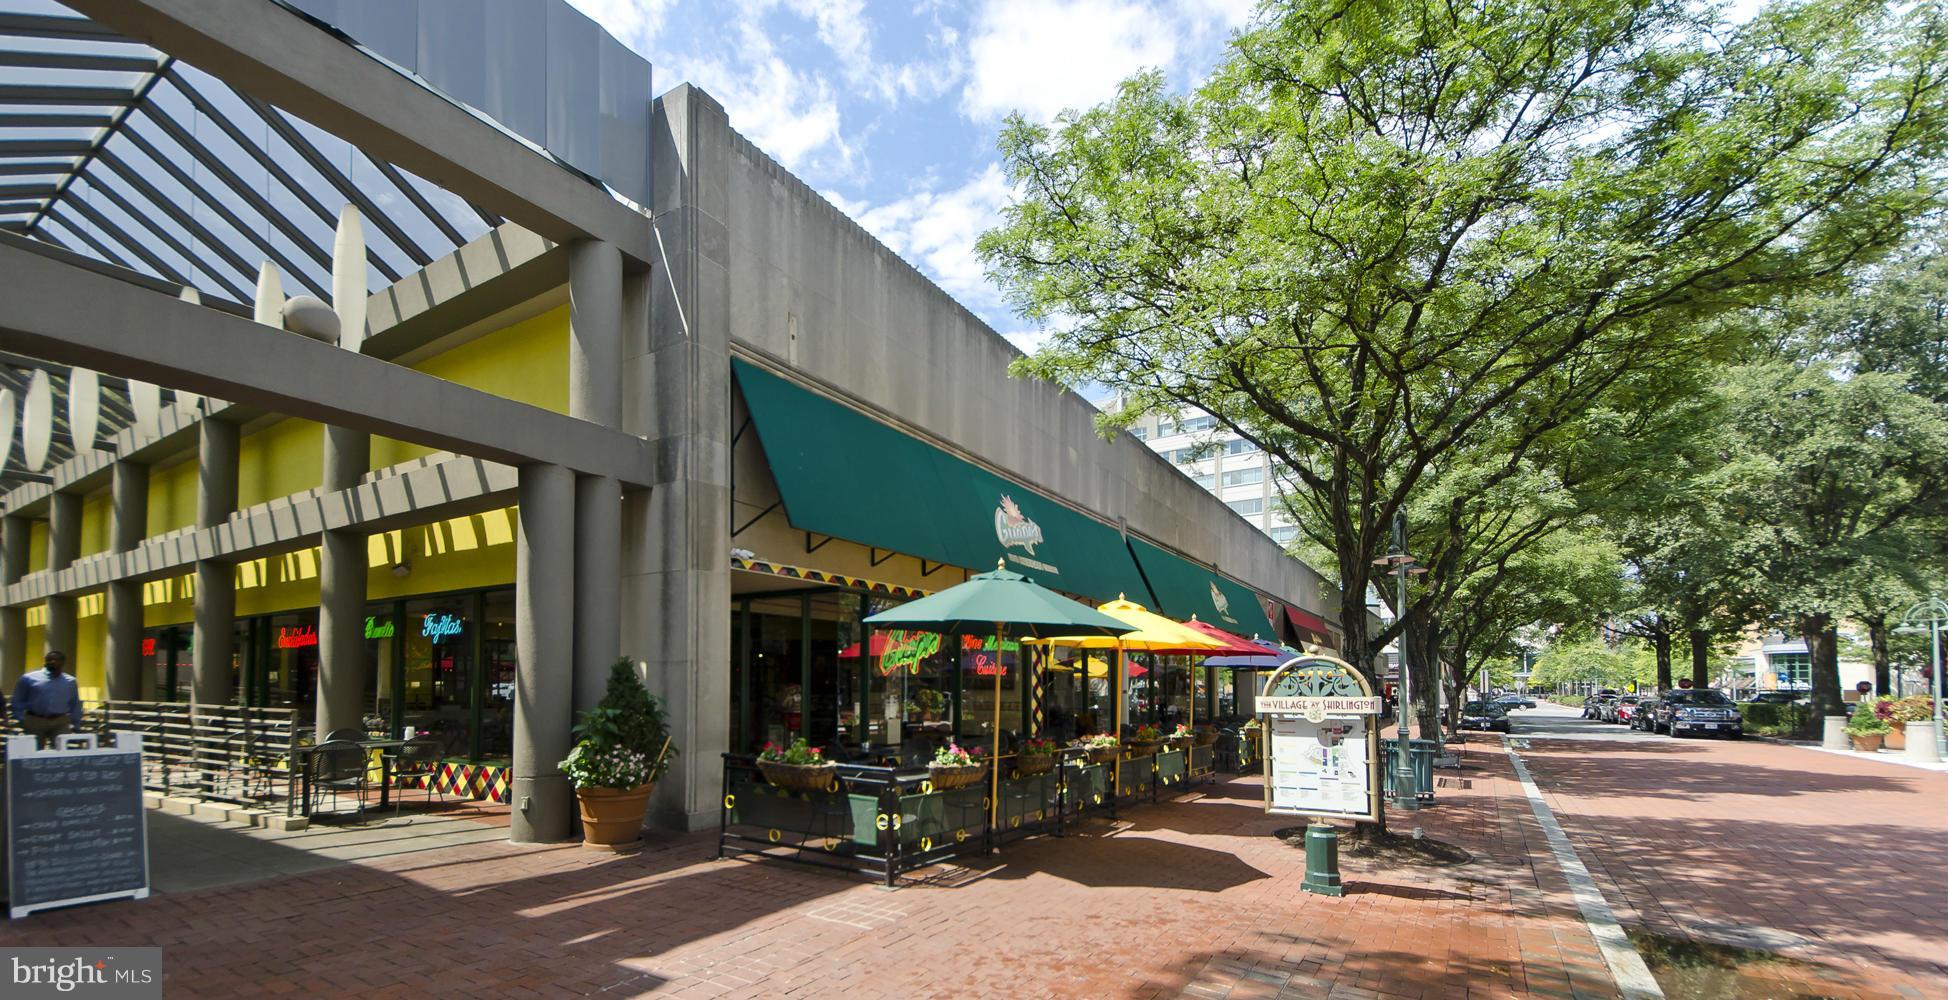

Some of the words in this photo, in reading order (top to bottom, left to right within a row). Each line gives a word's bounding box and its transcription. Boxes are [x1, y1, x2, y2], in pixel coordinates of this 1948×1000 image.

[422, 613, 463, 644] Fajitas
[1272, 700, 1308, 710] VILLAGE
[1323, 699, 1375, 711] SHIRLINGTON
